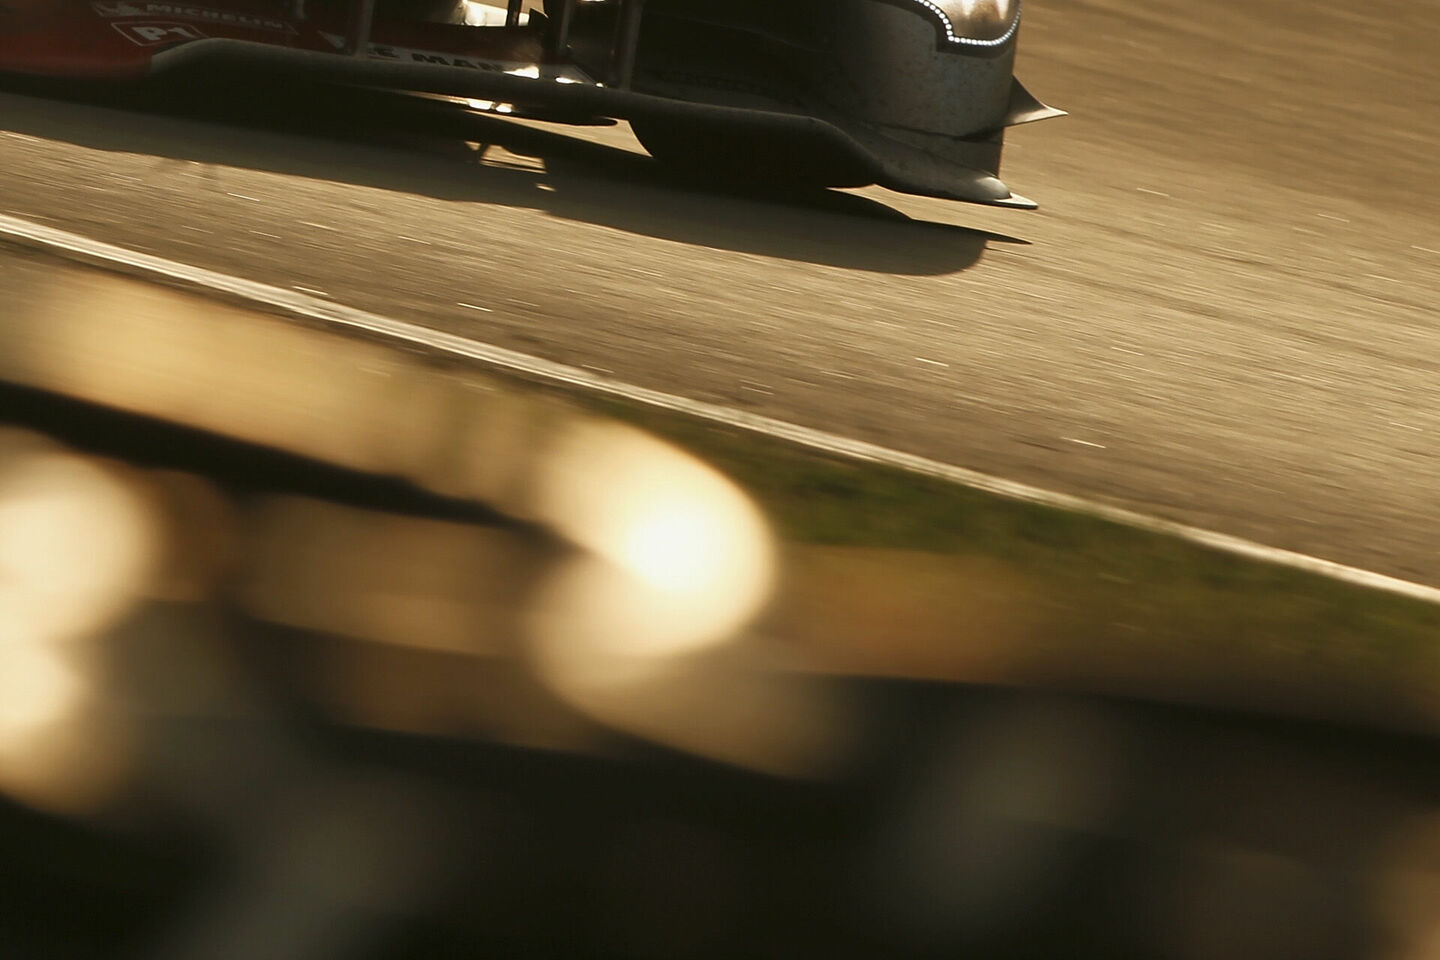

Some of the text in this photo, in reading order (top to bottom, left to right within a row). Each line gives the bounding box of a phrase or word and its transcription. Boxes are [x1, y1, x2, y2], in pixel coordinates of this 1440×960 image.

[146, 3, 284, 29] MICHELIN
[131, 26, 199, 41] P1
[410, 52, 504, 72] MAN
